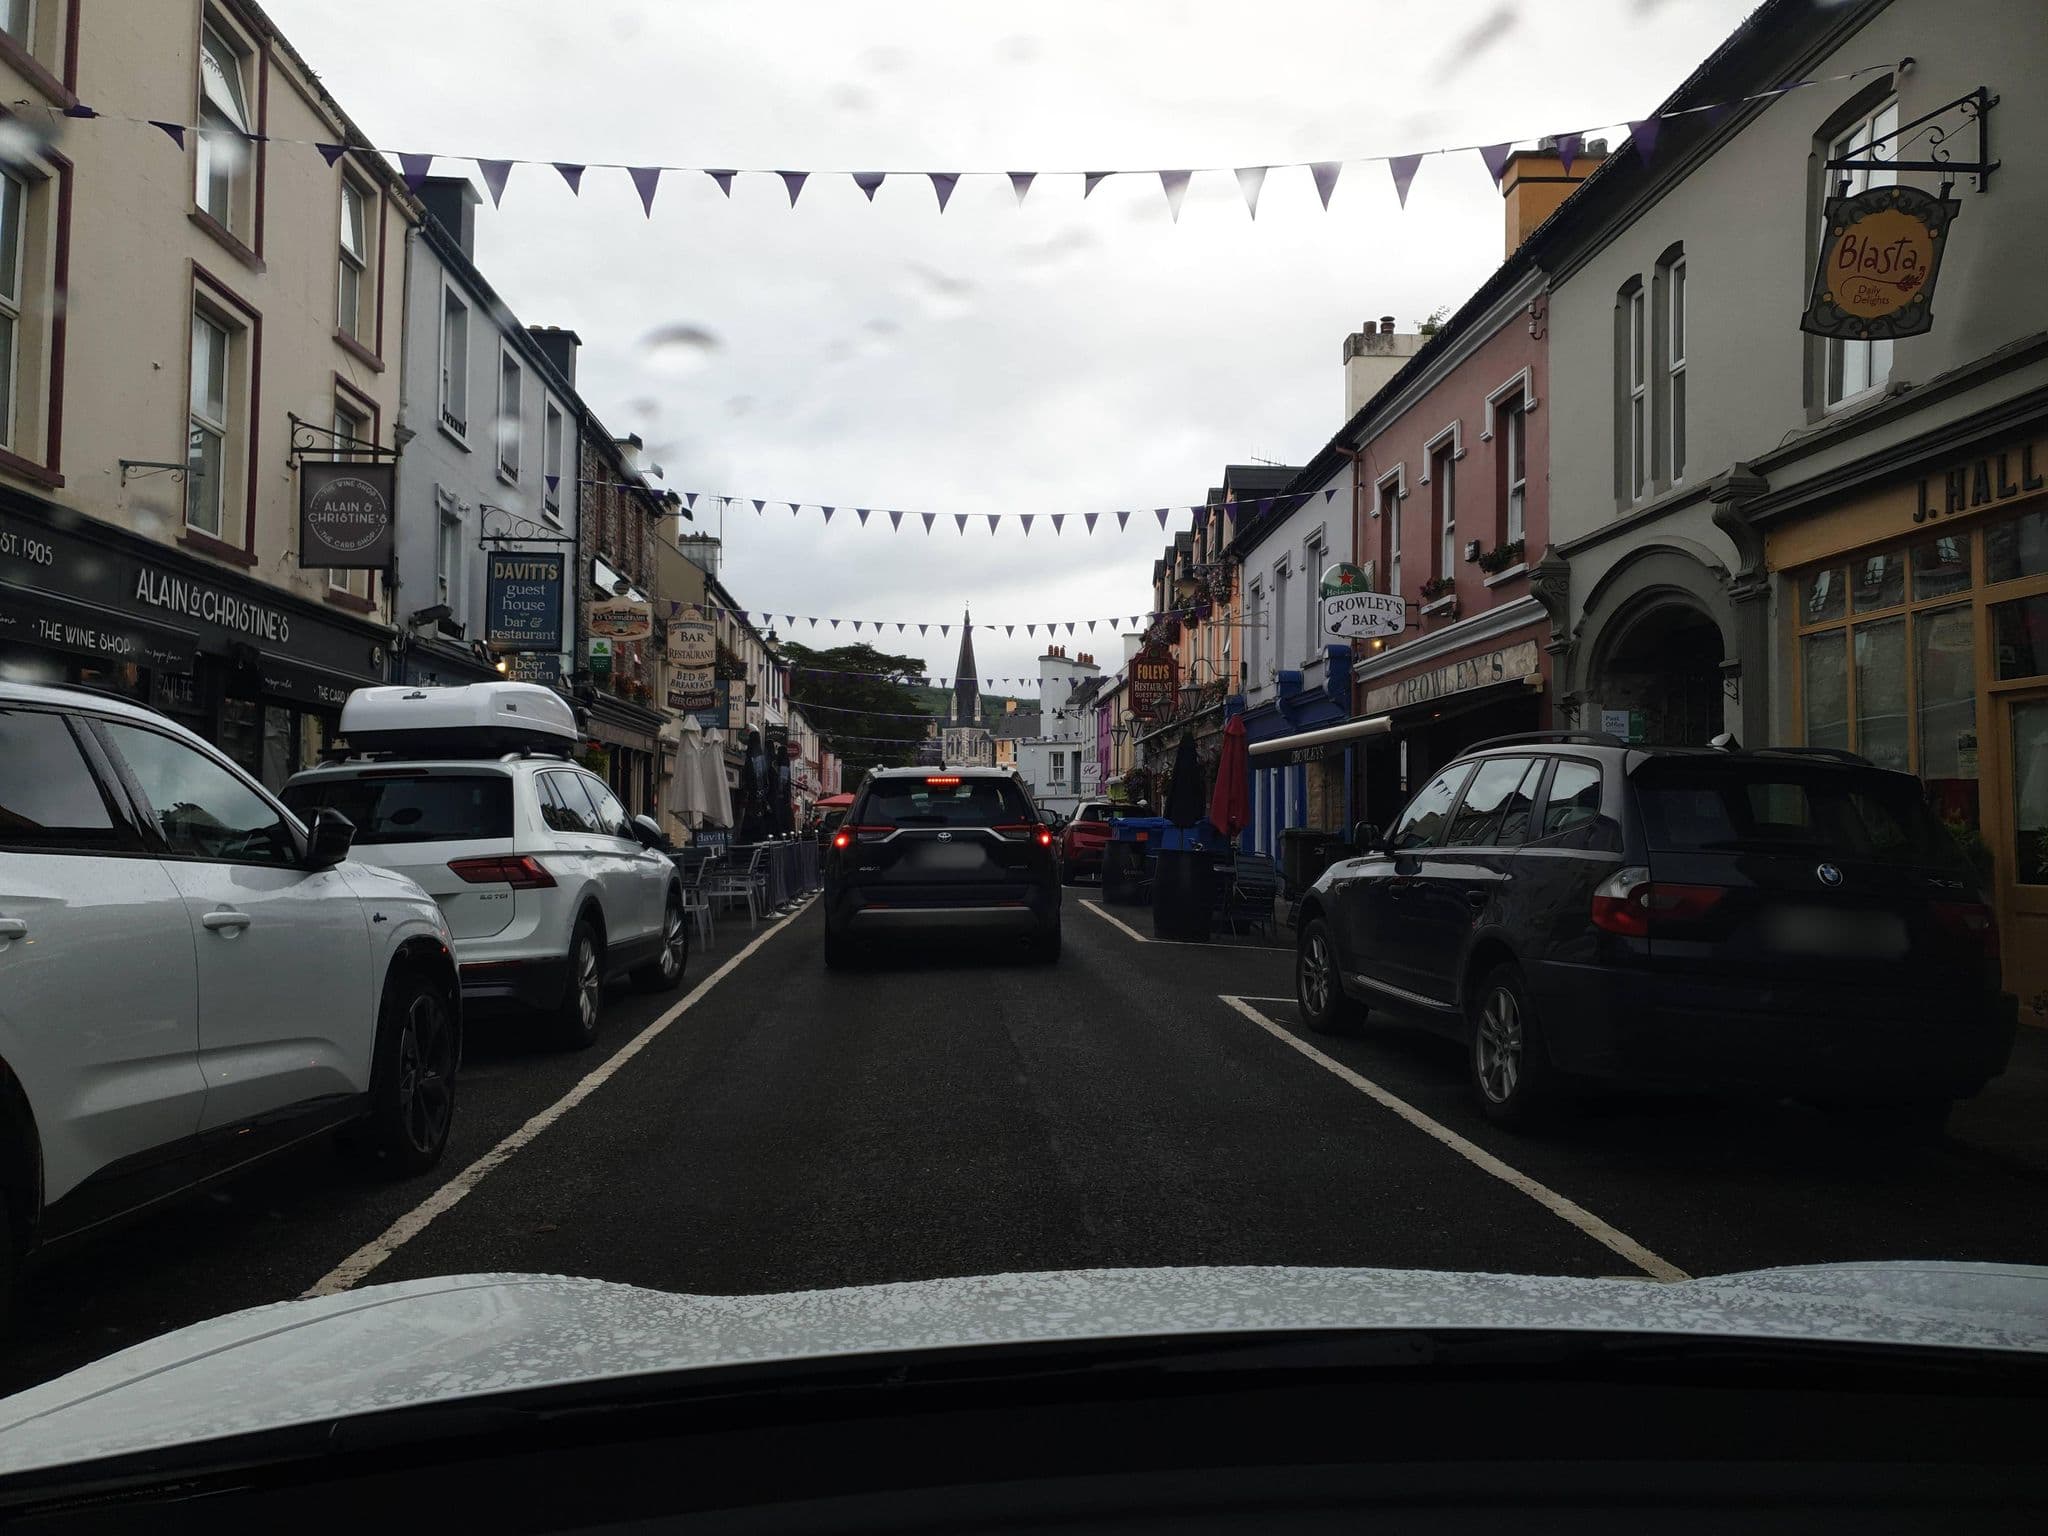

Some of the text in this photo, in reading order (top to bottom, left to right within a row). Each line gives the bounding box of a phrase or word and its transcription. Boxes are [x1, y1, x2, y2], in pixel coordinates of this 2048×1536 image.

[1838, 234, 1918, 274] Blasta
[1858, 285, 1881, 297] Daily
[1853, 295, 1890, 307] Delights
[1913, 446, 2043, 523] J. HALL
[324, 501, 360, 512] ALAIN
[308, 512, 388, 524] CHRISTINE'S
[22, 538, 53, 566] 1905
[495, 562, 559, 580] DAVITTS
[505, 584, 546, 599] guest
[136, 567, 188, 614] ALAIN
[202, 591, 289, 643] CHRISTINE'S
[502, 596, 546, 611] house
[1328, 596, 1403, 615] CROWLEY'S
[504, 615, 527, 627] bar
[1352, 614, 1379, 625] BAR
[39, 619, 62, 641] THE
[65, 625, 97, 649] WINE
[99, 633, 131, 654] SHOP
[491, 629, 556, 640] restaurant
[680, 631, 706, 642] BAR
[669, 648, 714, 659] RESTAURANT
[515, 656, 546, 670] beer
[508, 668, 554, 682] garden
[677, 670, 696, 681] BED
[1137, 663, 1170, 680] FOLEYS
[670, 679, 713, 690] BREAKFAST
[1395, 652, 1504, 706] CROWLEY'S
